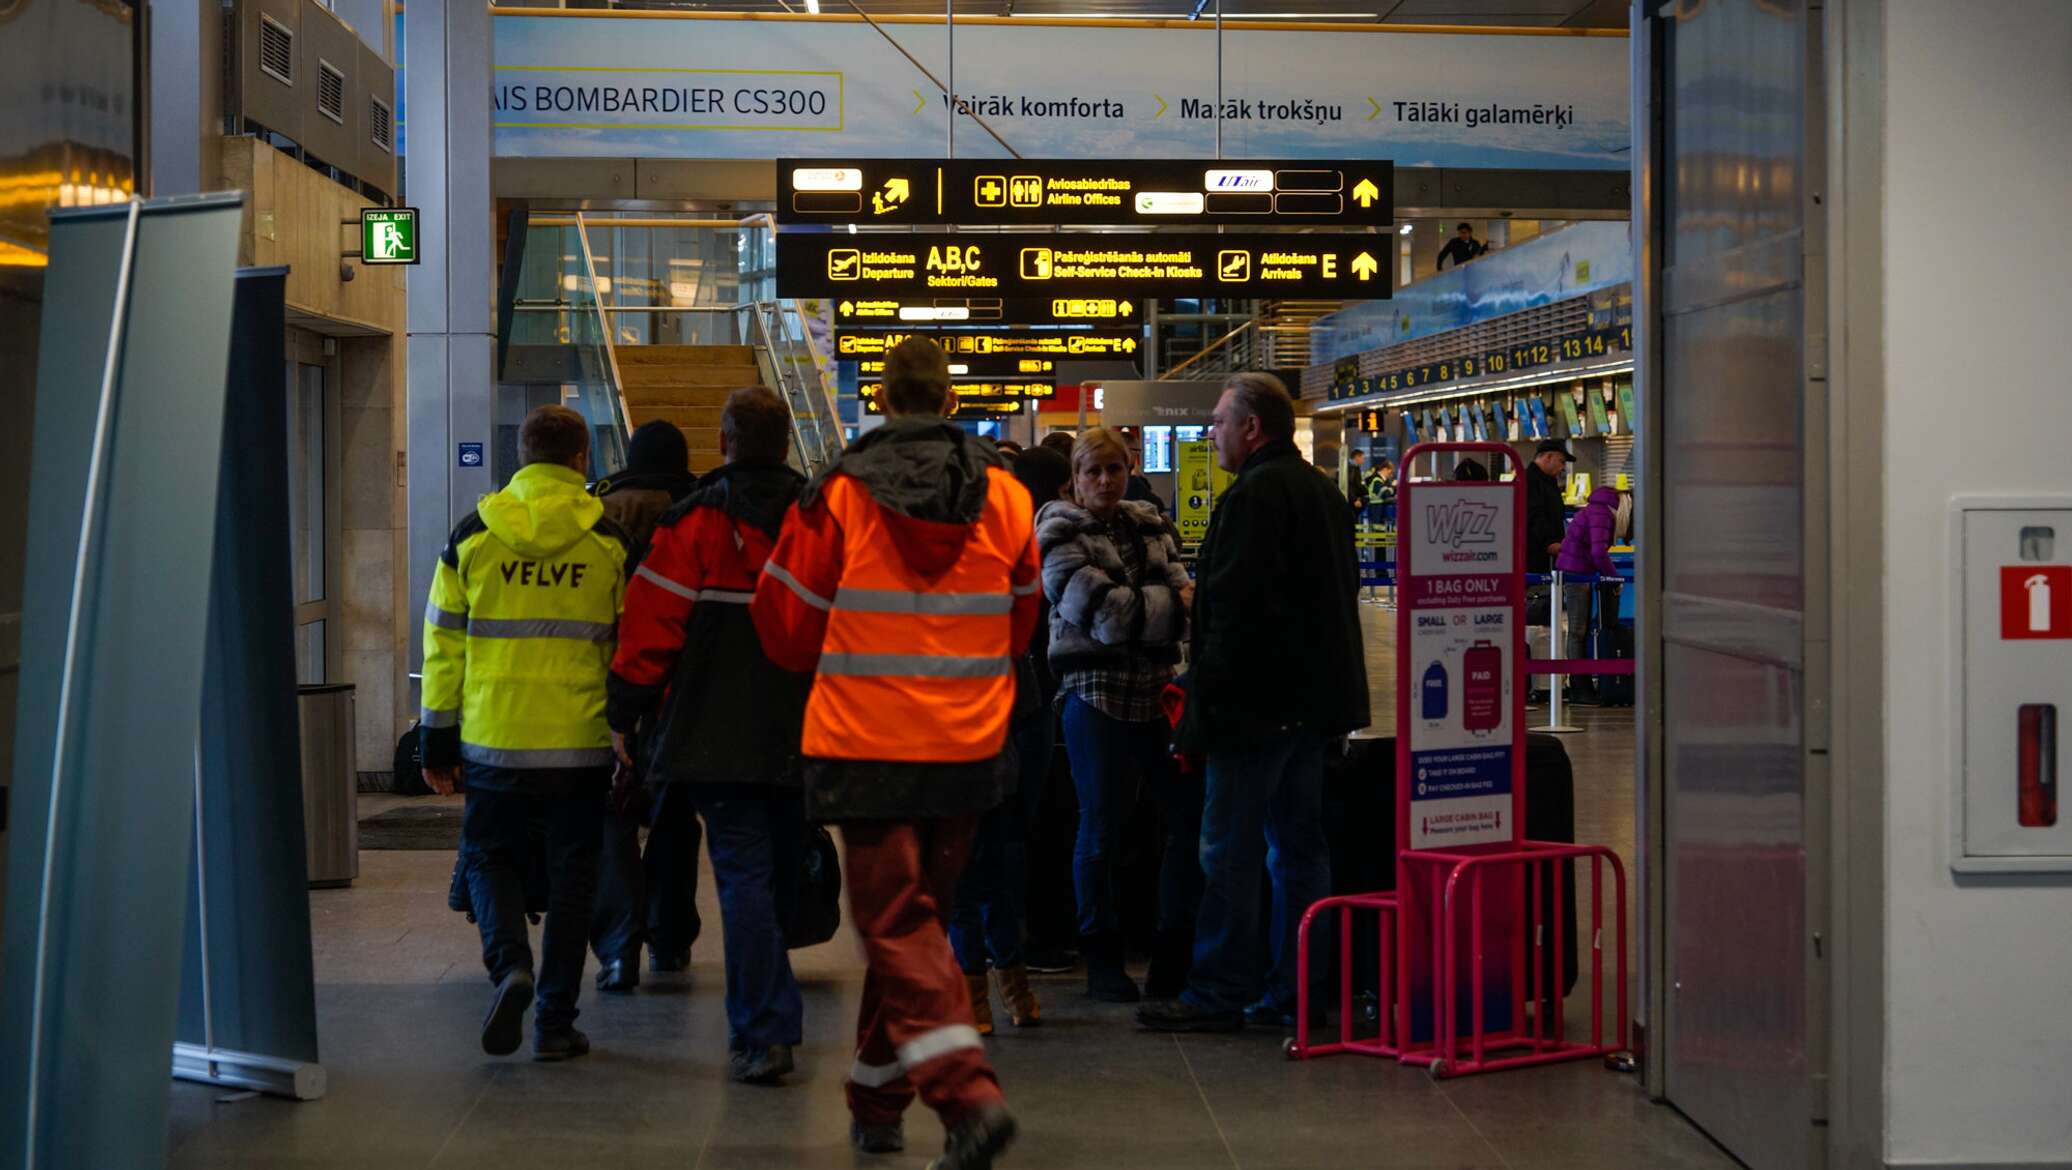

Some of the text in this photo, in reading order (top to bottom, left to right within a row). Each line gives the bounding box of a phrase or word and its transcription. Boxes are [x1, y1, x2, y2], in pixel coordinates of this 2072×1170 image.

[535, 86, 726, 113] BOMBARDIER
[734, 88, 826, 115] CS300
[1020, 96, 1124, 118] komforta
[1257, 99, 1342, 126] trokšņu
[1393, 101, 1573, 130] Tālāki galamērķi
[1046, 193, 1121, 205] Airline Offices
[366, 213, 412, 221] IZEJA EXIT
[862, 252, 916, 264] Izlidošana
[925, 245, 981, 274] A,B,C
[1145, 251, 1192, 263] automāti
[1260, 252, 1317, 265] Atlidošana
[1053, 266, 1203, 278] Self-Service Check-in Kiosks
[1322, 253, 1337, 279] E
[862, 267, 915, 281] Departure
[927, 275, 998, 287] Sektori/Gates
[1260, 268, 1302, 280] Arrivals
[1347, 383, 1356, 397] 2
[1362, 381, 1370, 394] 3
[1379, 377, 1387, 391] 4
[1390, 375, 1398, 389] 5
[1406, 371, 1415, 386] 6
[1422, 368, 1430, 383] 7
[1440, 365, 1449, 380] 8
[1464, 359, 1474, 375] 9
[1488, 355, 1504, 371] 10
[1515, 351, 1530, 367] 11
[1530, 346, 1549, 364] 12
[1563, 339, 1582, 358] 13
[1584, 335, 1603, 354] 14
[1442, 549, 1498, 563] wizzair.com
[501, 560, 587, 588] VELVE
[1427, 578, 1500, 594] 1 BAG ONLY
[1417, 613, 1504, 627] SMALL OR LARGE
